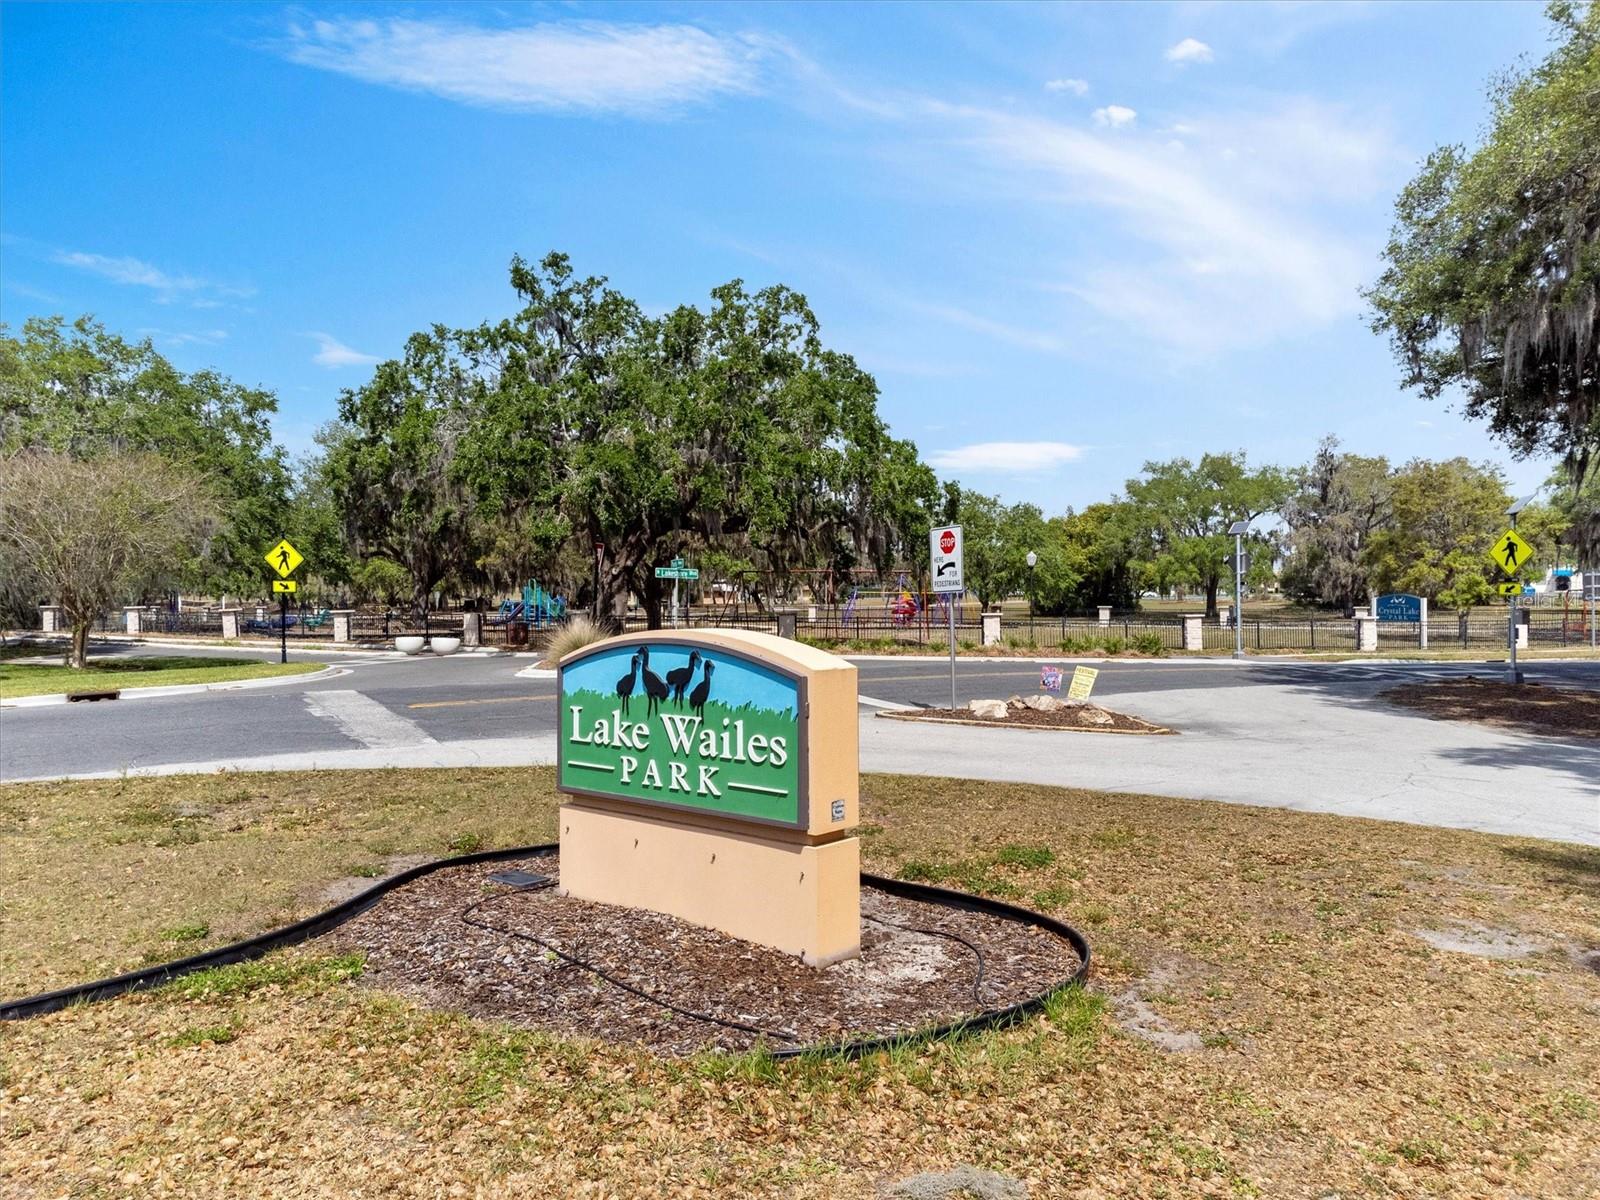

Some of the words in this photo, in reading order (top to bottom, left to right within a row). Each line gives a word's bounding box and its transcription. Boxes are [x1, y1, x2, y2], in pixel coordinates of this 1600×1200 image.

[941, 538, 954, 547] STOP
[1378, 607, 1401, 616] Crystal
[1403, 607, 1420, 615] Lake
[569, 706, 649, 750] Lake
[659, 714, 788, 766] Wailes
[620, 756, 722, 796] PARK
